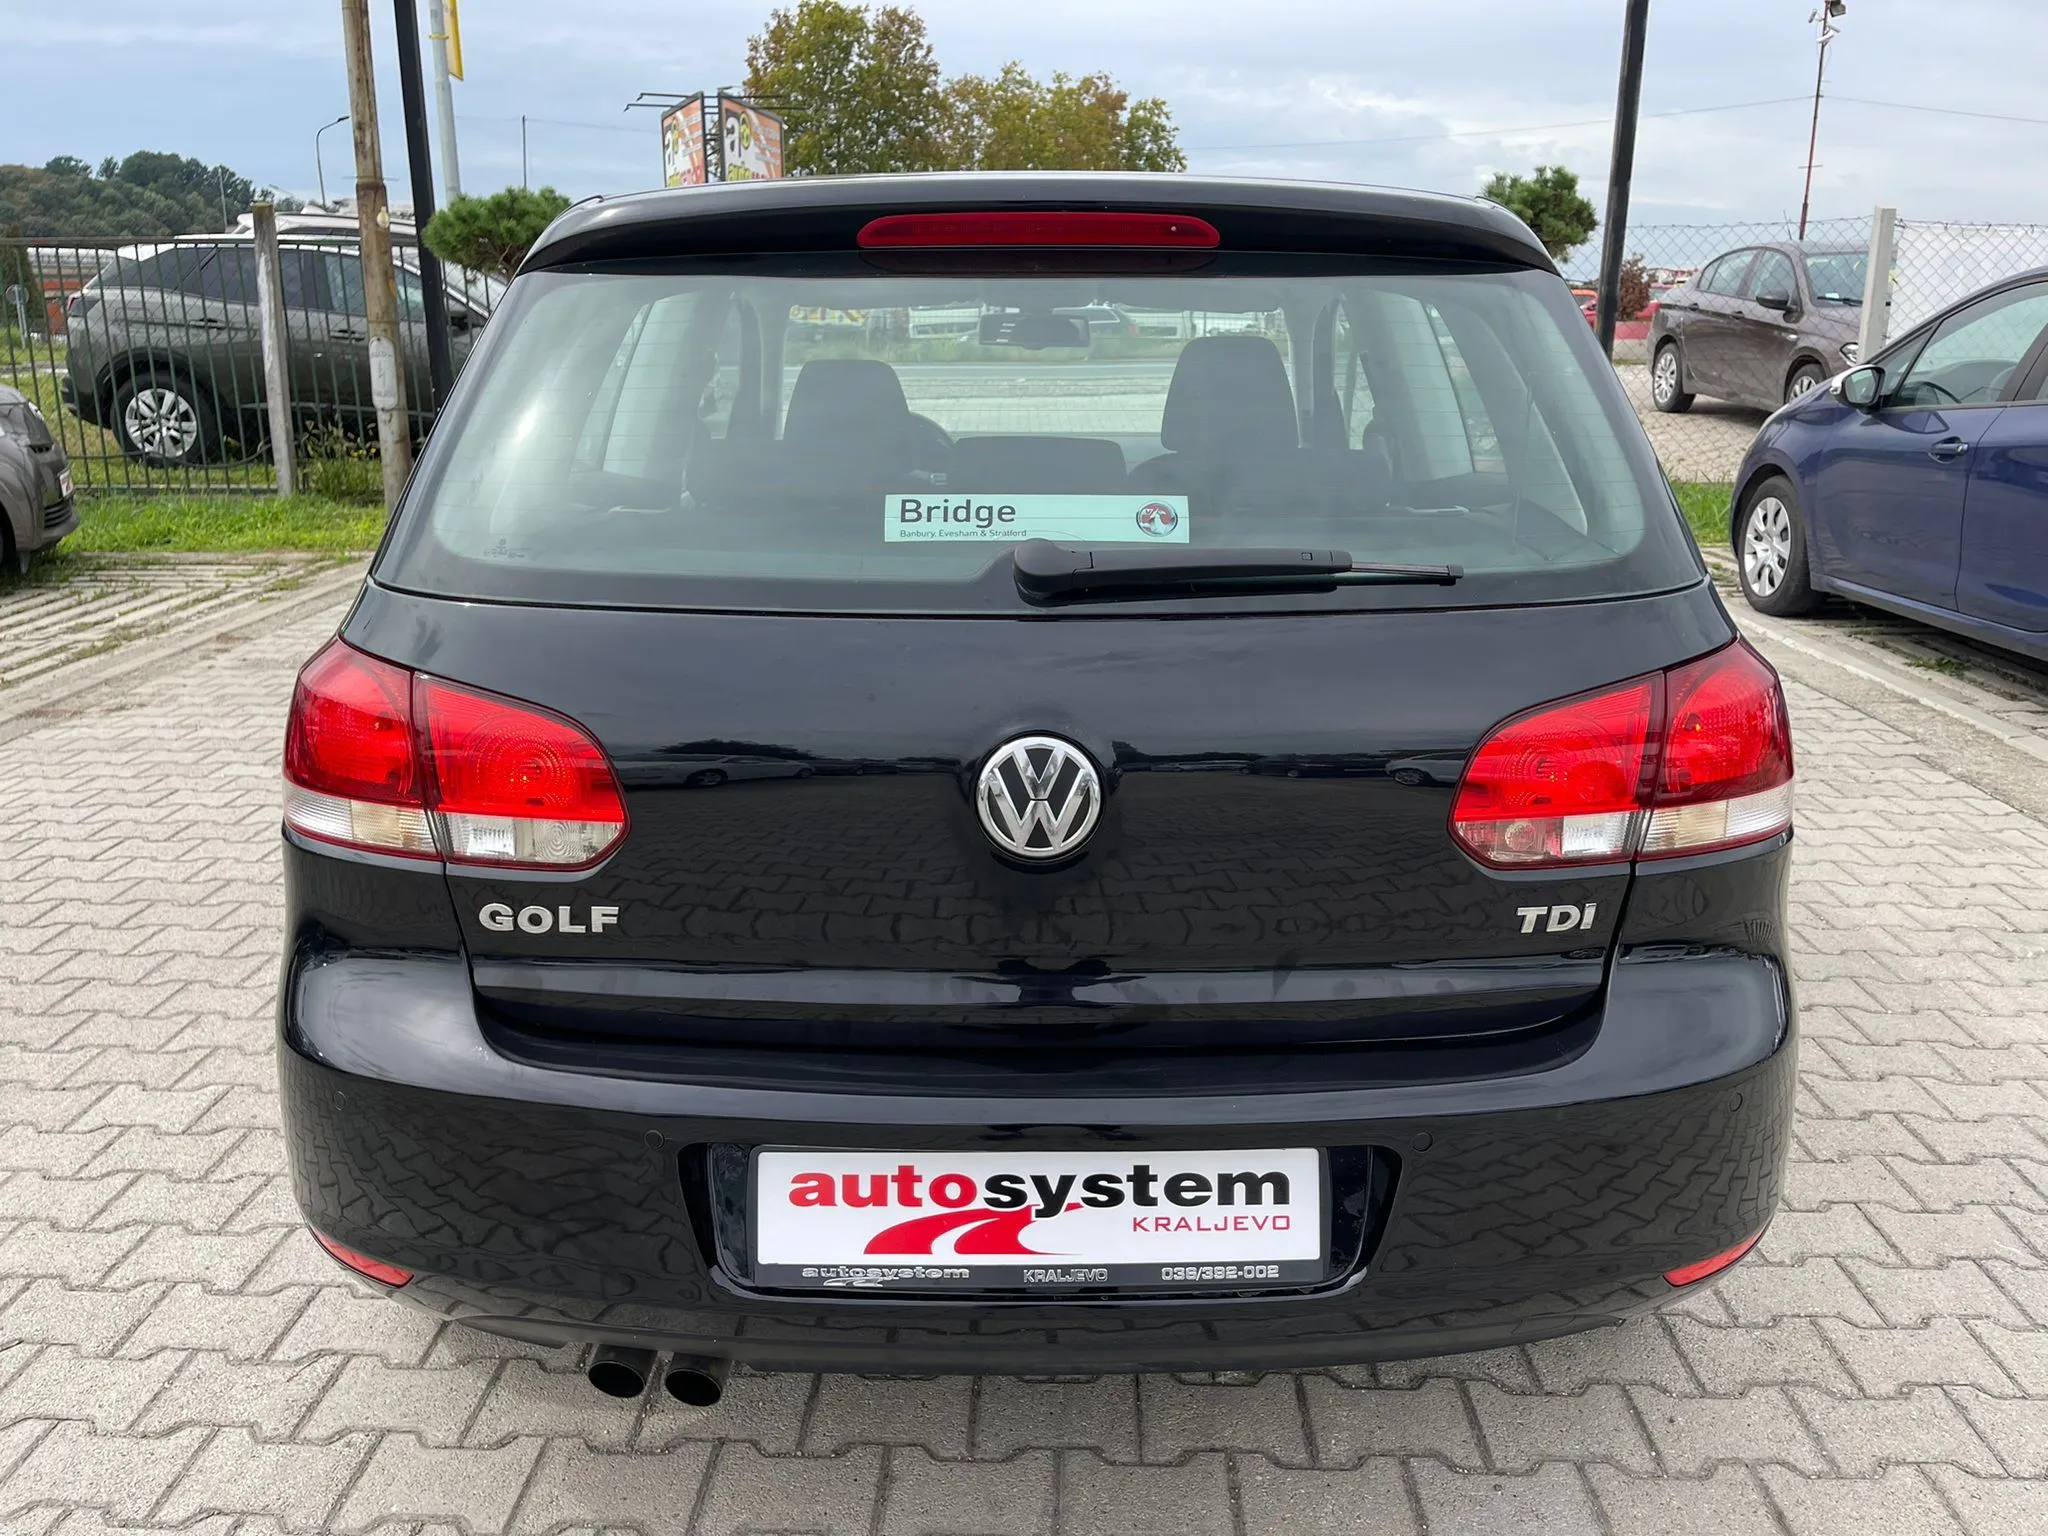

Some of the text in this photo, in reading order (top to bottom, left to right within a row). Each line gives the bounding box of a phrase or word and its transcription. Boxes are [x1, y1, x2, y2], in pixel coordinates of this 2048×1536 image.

[900, 498, 1016, 528] Bridge
[939, 529, 978, 537] Evesham
[989, 529, 1027, 537] Stratford
[479, 902, 620, 934] GOLF
[789, 1164, 1290, 1218] autosystem
[1131, 1214, 1291, 1232] KRALJEVO
[801, 1265, 970, 1280] autosystem
[1023, 1268, 1109, 1283] KRALJEVO
